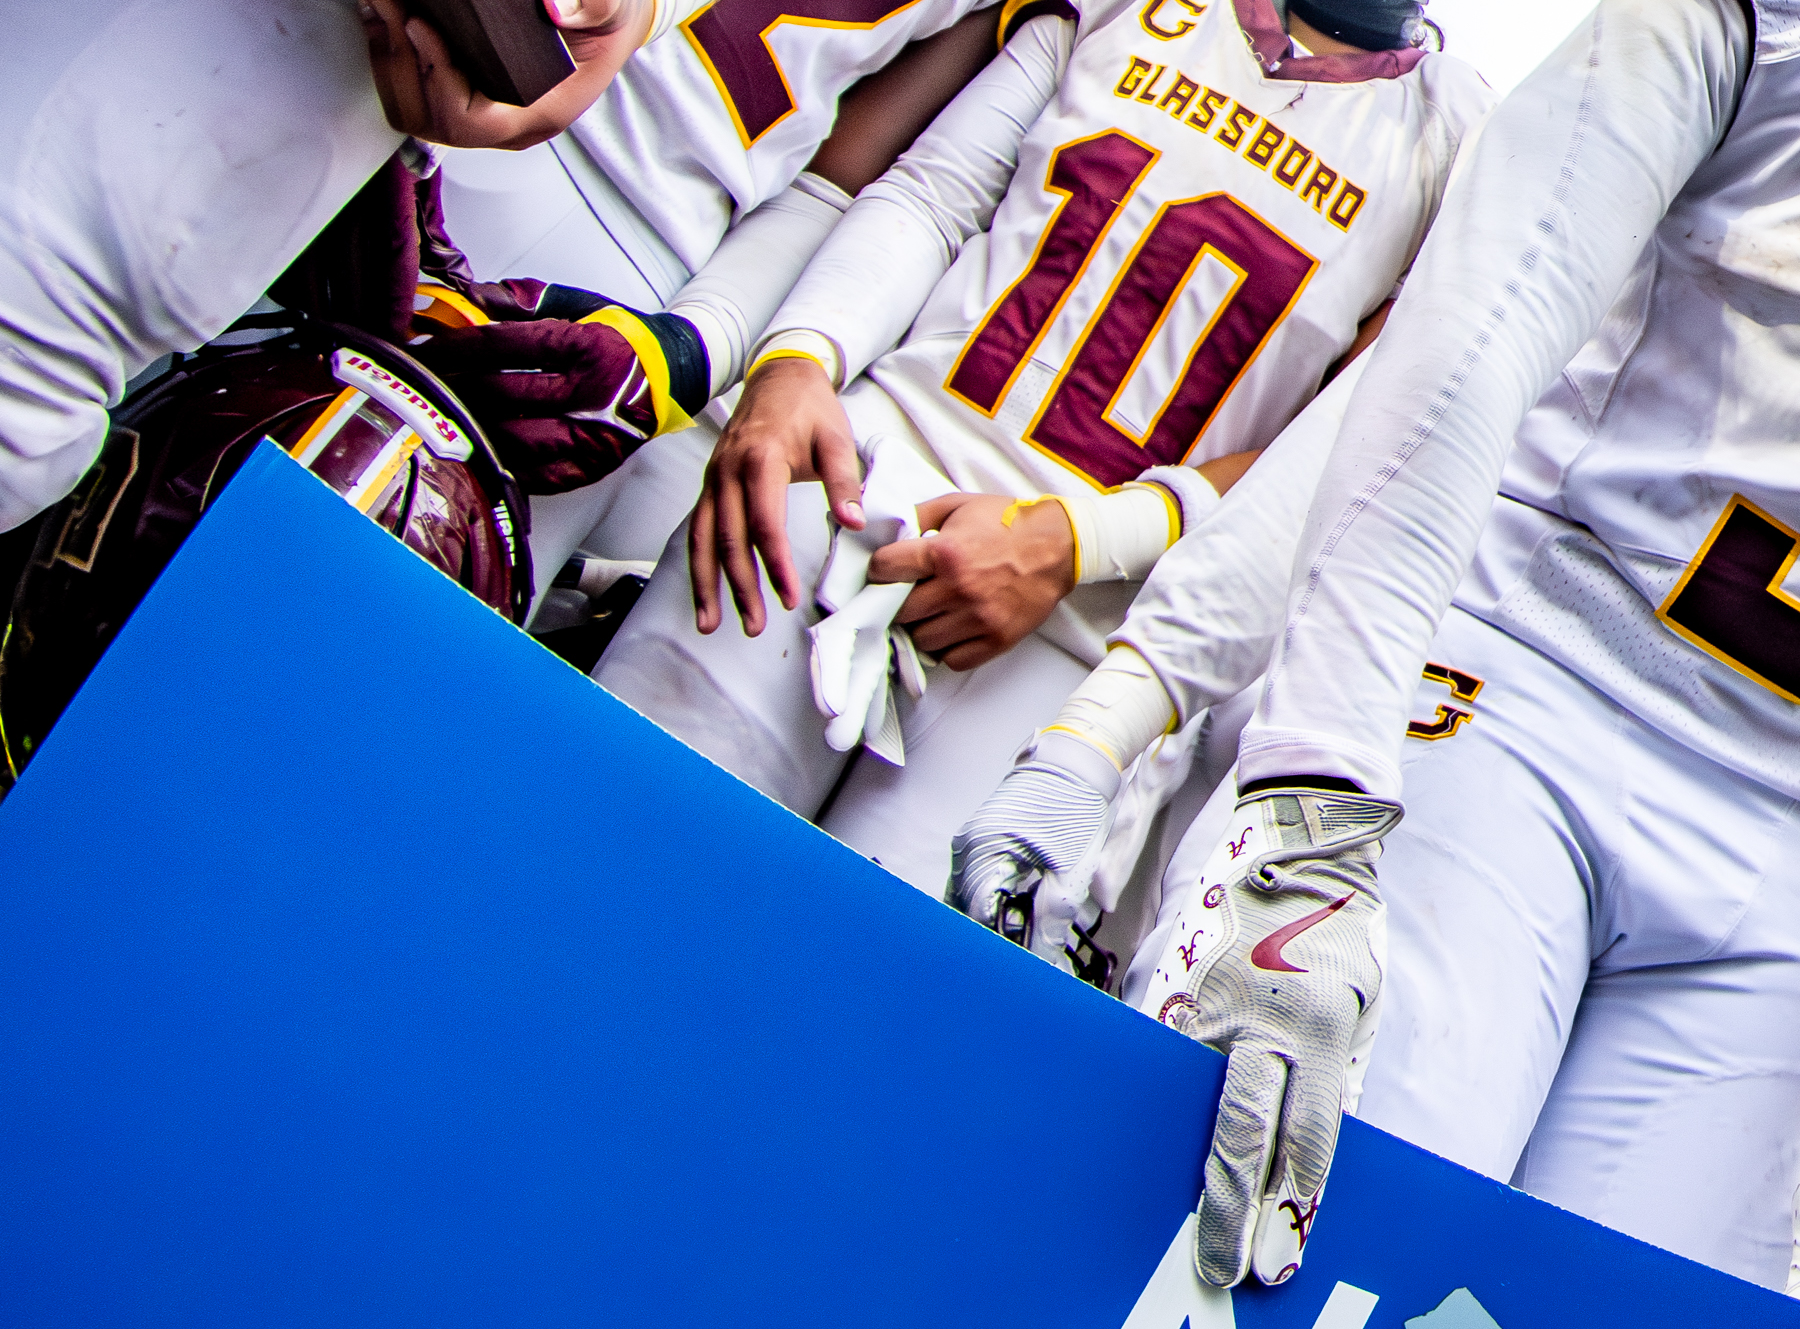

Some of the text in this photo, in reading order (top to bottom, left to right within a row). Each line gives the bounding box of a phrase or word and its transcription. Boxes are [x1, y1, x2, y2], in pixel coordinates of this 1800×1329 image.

[1113, 55, 1367, 233] GLASSBORO
[346, 356, 458, 442] Riddell
[943, 127, 1321, 494] 10
